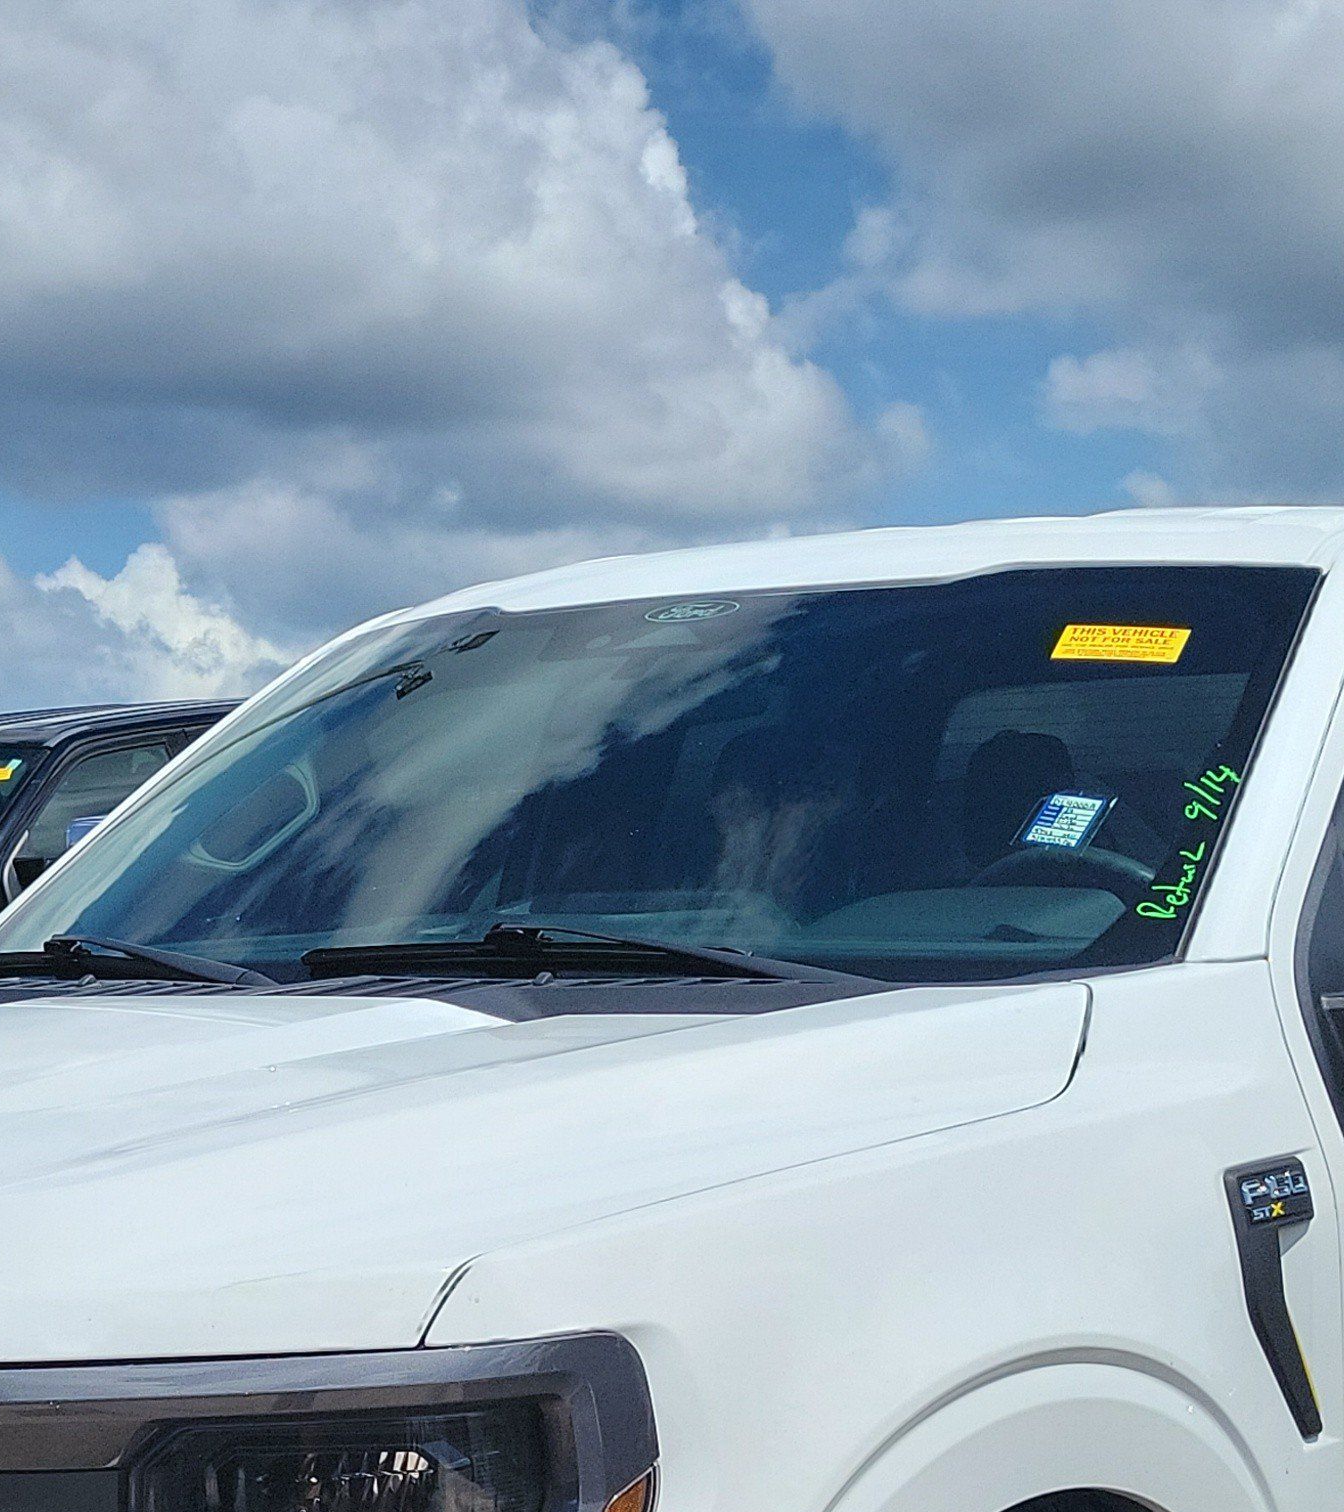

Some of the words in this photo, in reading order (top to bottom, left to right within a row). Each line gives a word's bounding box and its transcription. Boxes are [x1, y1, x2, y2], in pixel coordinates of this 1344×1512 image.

[658, 603, 726, 620] Ford
[1071, 627, 1107, 636] THIS
[1112, 628, 1178, 639] VEHICLE
[1102, 636, 1131, 644] FOR
[1136, 637, 1170, 645] SALE
[1184, 765, 1243, 820] 9/14
[1252, 1202, 1286, 1221] STX
